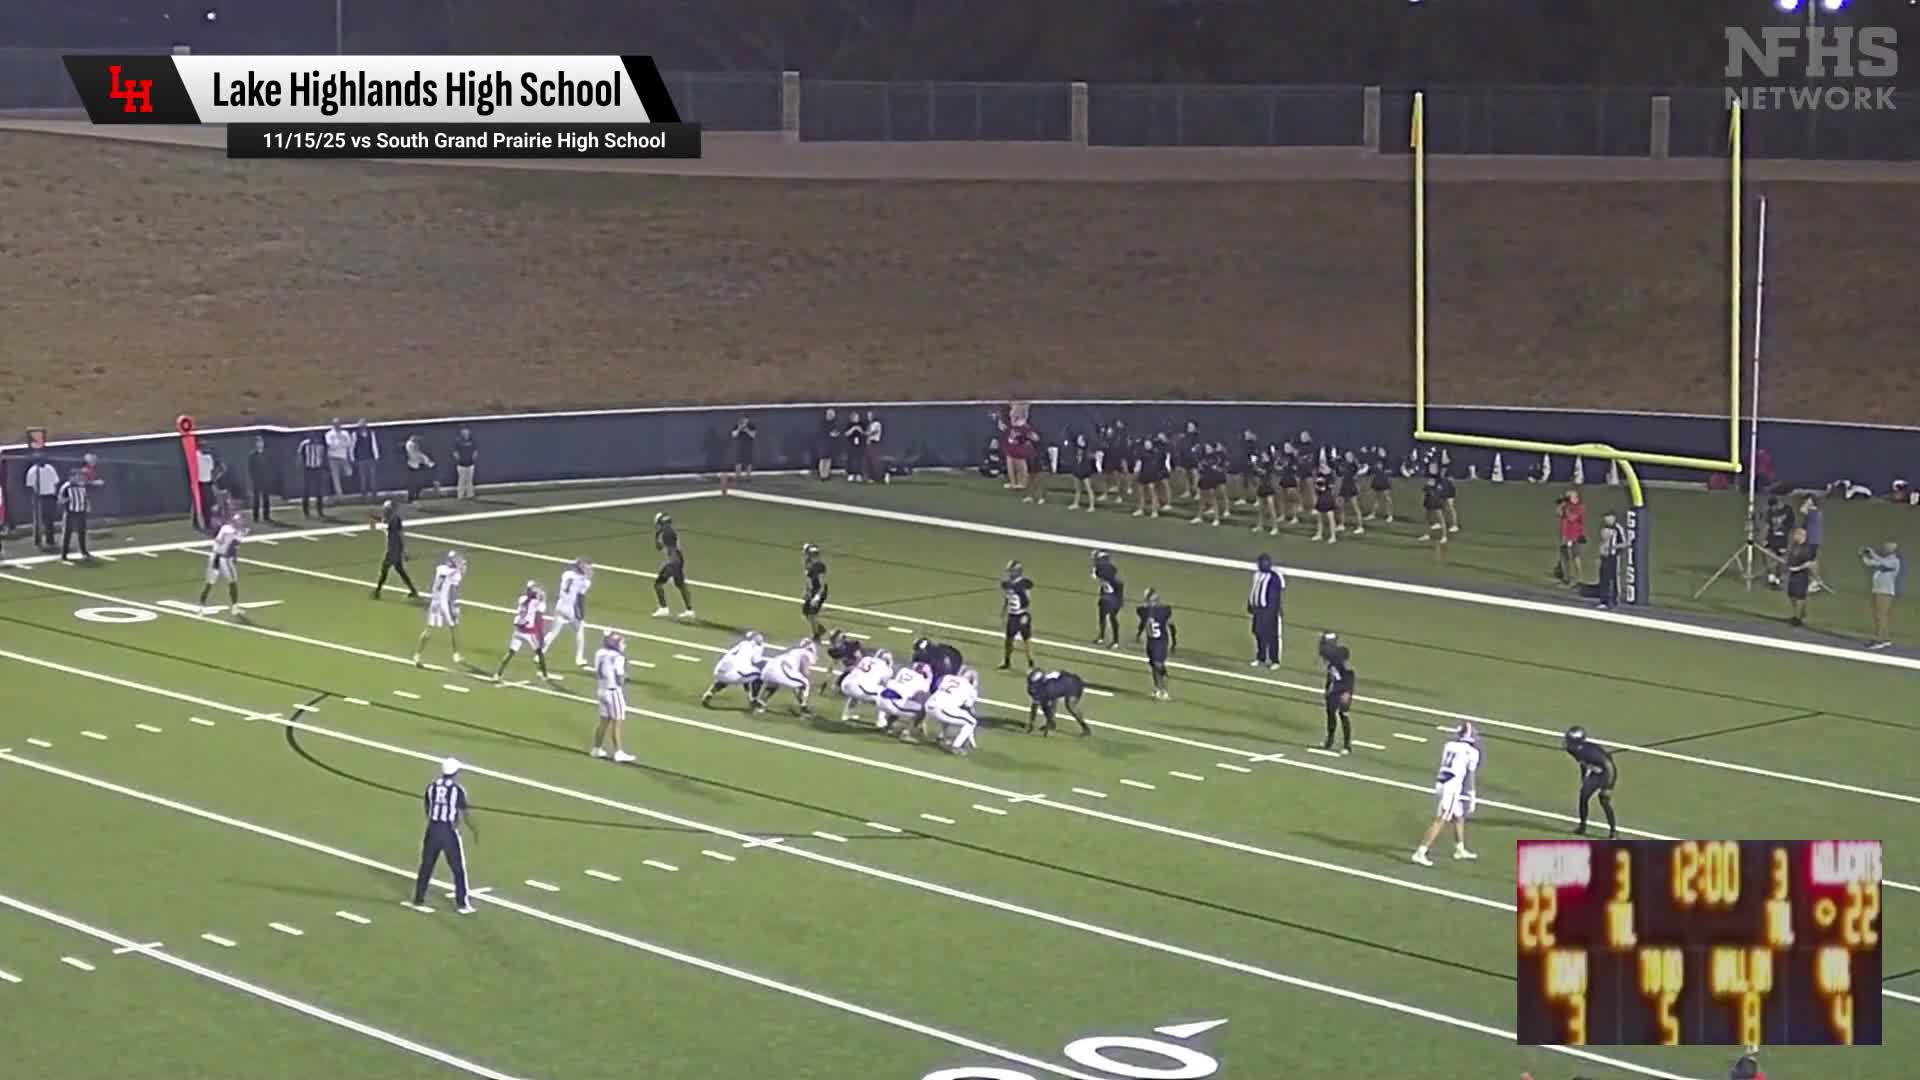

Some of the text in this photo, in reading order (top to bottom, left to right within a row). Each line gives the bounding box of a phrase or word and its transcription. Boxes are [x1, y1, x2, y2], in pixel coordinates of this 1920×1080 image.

[1673, 841, 1740, 904] 12:00
[1518, 886, 1557, 947] 22
[1842, 883, 1879, 945] 22
